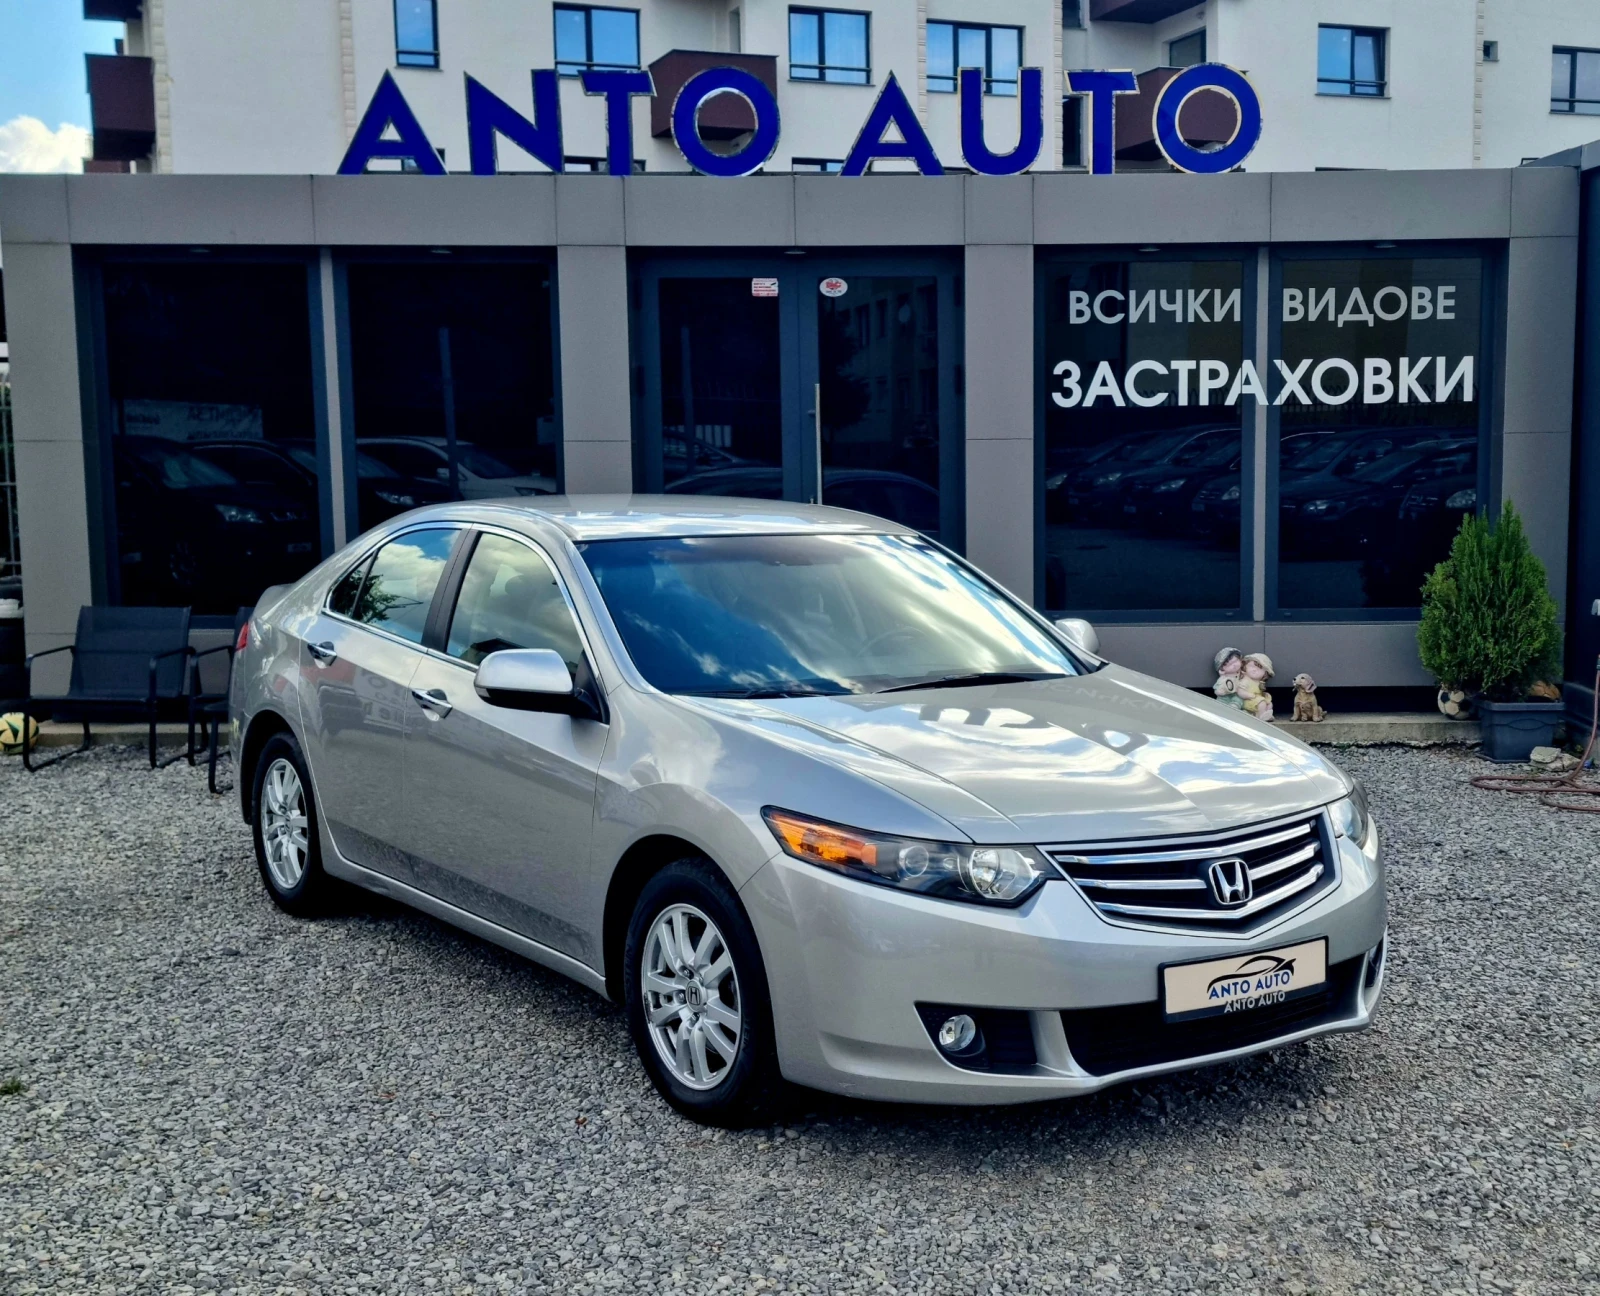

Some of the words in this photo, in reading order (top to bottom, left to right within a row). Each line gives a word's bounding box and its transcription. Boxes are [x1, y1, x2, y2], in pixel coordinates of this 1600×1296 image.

[337, 66, 781, 177] ANTO
[839, 62, 1264, 176] AUTO
[1069, 288, 1241, 324] ВСИЧКИ
[1282, 285, 1456, 327] ВИДОВЕ
[1051, 356, 1474, 407] ЗАСТРАХОВКИ
[1209, 980, 1251, 1000] ANTO
[1255, 971, 1291, 992] AUTO
[1224, 996, 1256, 1013] ANTO
[1258, 990, 1286, 1007] AUTO
